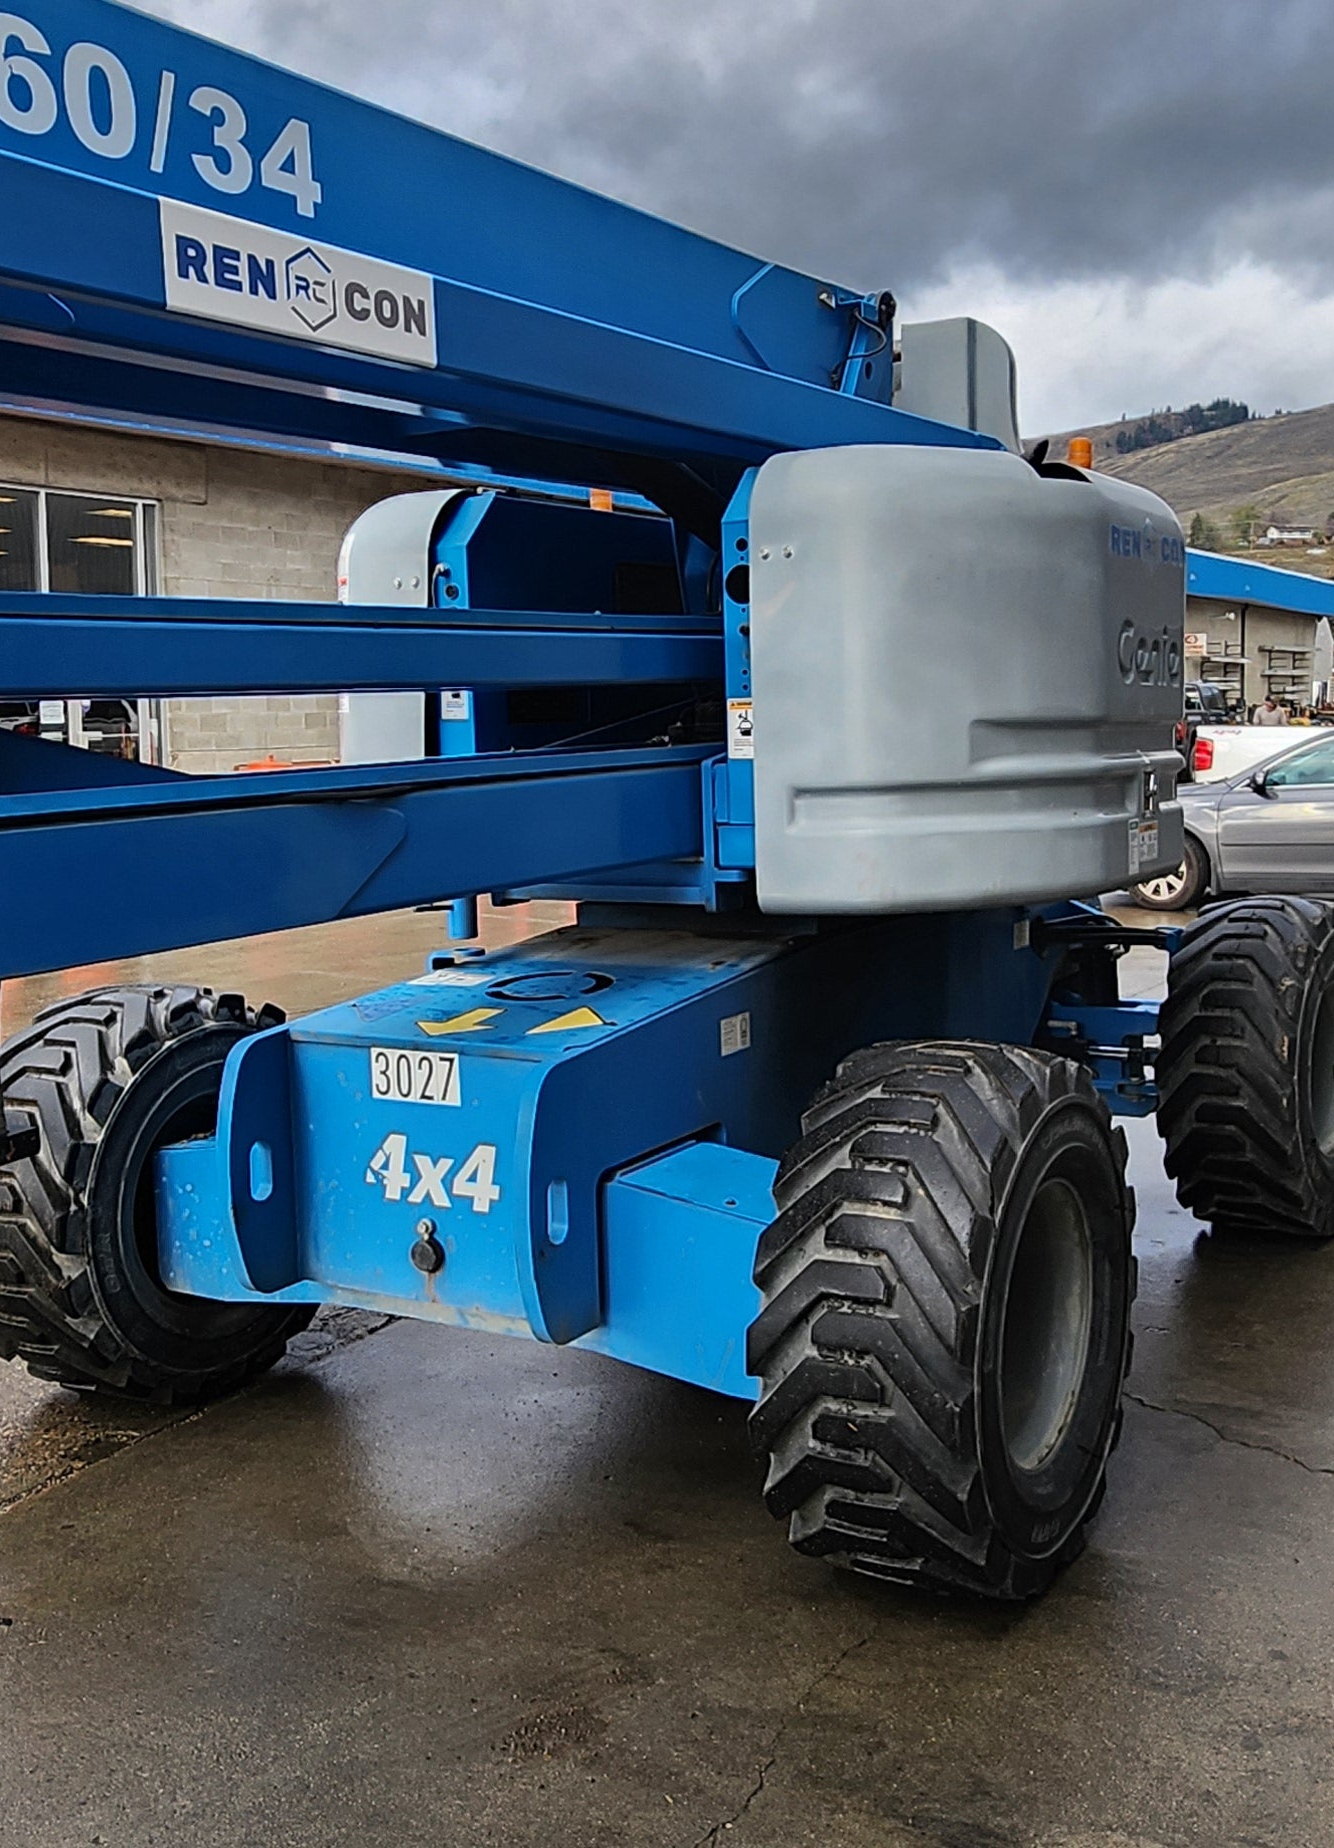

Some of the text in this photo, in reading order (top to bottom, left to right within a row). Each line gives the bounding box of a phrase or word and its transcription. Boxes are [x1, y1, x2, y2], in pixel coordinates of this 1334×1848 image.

[175, 233, 427, 337] REN RC CON
[1110, 524, 1141, 558] REN
[375, 1051, 455, 1101] 3027
[366, 1133, 501, 1213] 4x4
